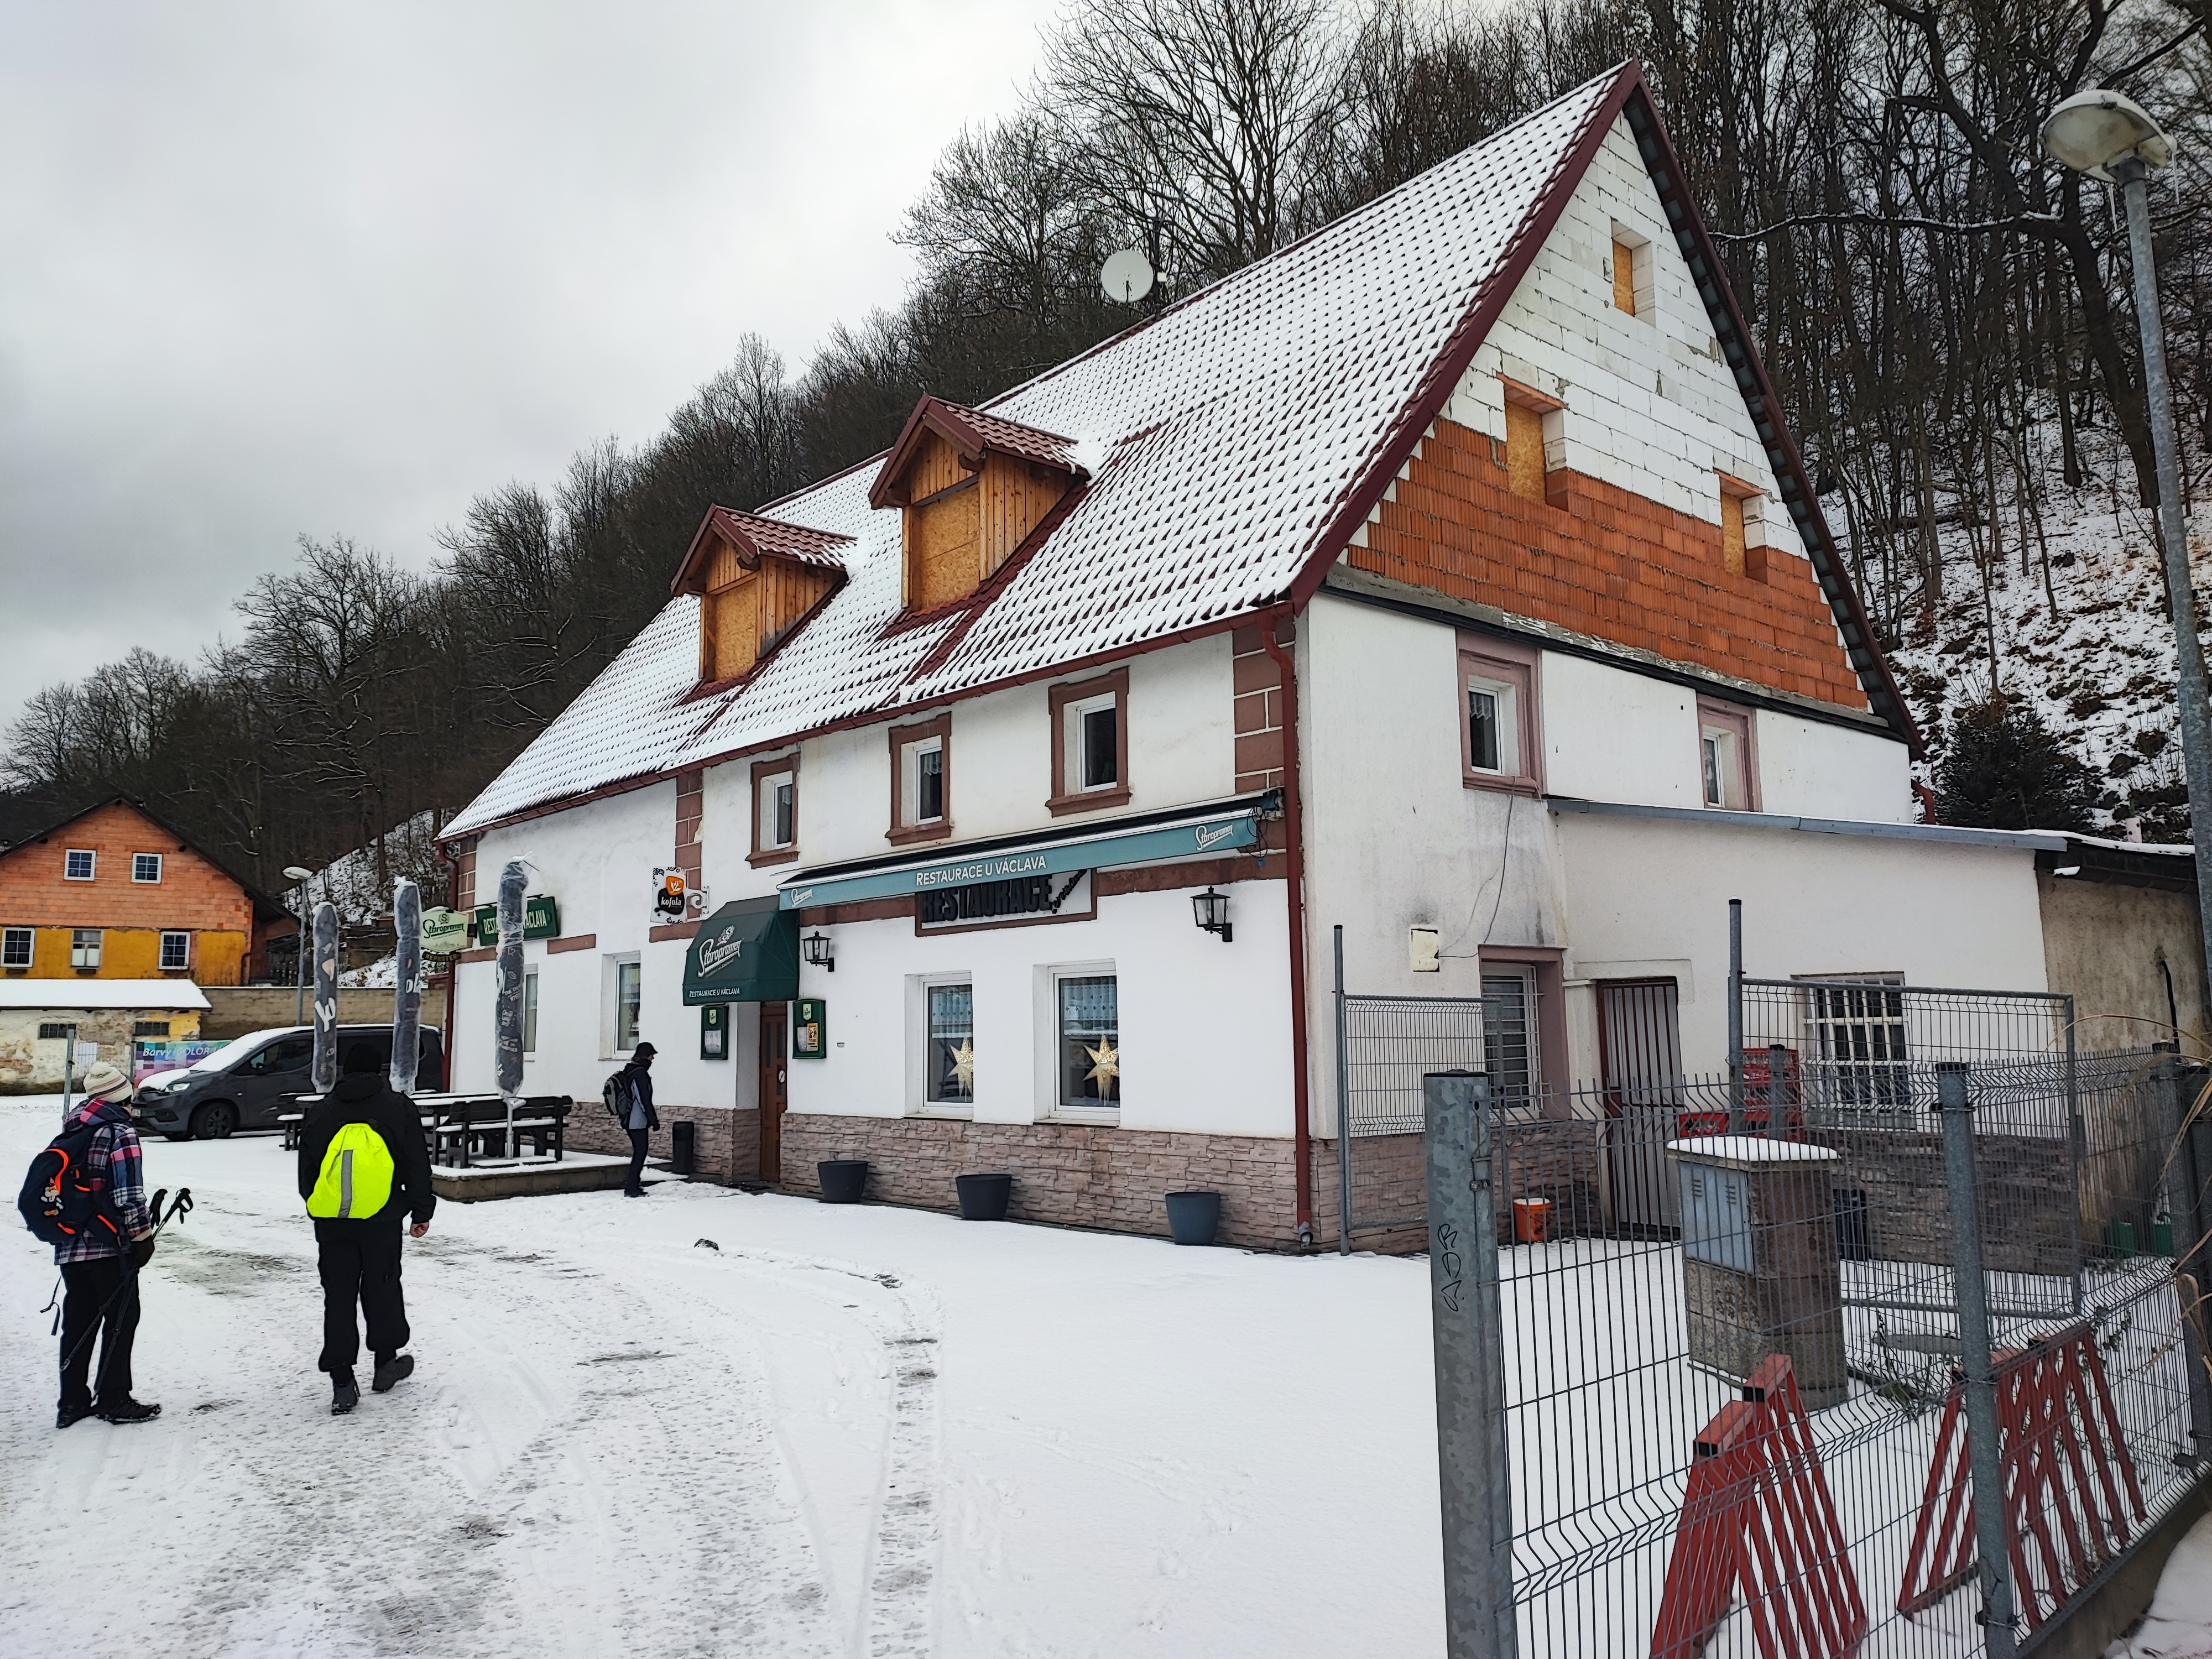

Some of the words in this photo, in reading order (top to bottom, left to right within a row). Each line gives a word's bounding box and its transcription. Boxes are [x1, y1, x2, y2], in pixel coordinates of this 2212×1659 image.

[1196, 825, 1234, 851] Staropramen
[916, 864, 983, 886] RESTAURACE
[985, 863, 993, 876] U
[995, 855, 1046, 875] VÁCLAVA
[661, 896, 681, 908] kofola
[422, 919, 465, 938] Staropramen
[697, 938, 743, 977] Staropramen
[689, 989, 716, 998] RESTAURACE
[143, 1047, 171, 1057] Barvy
